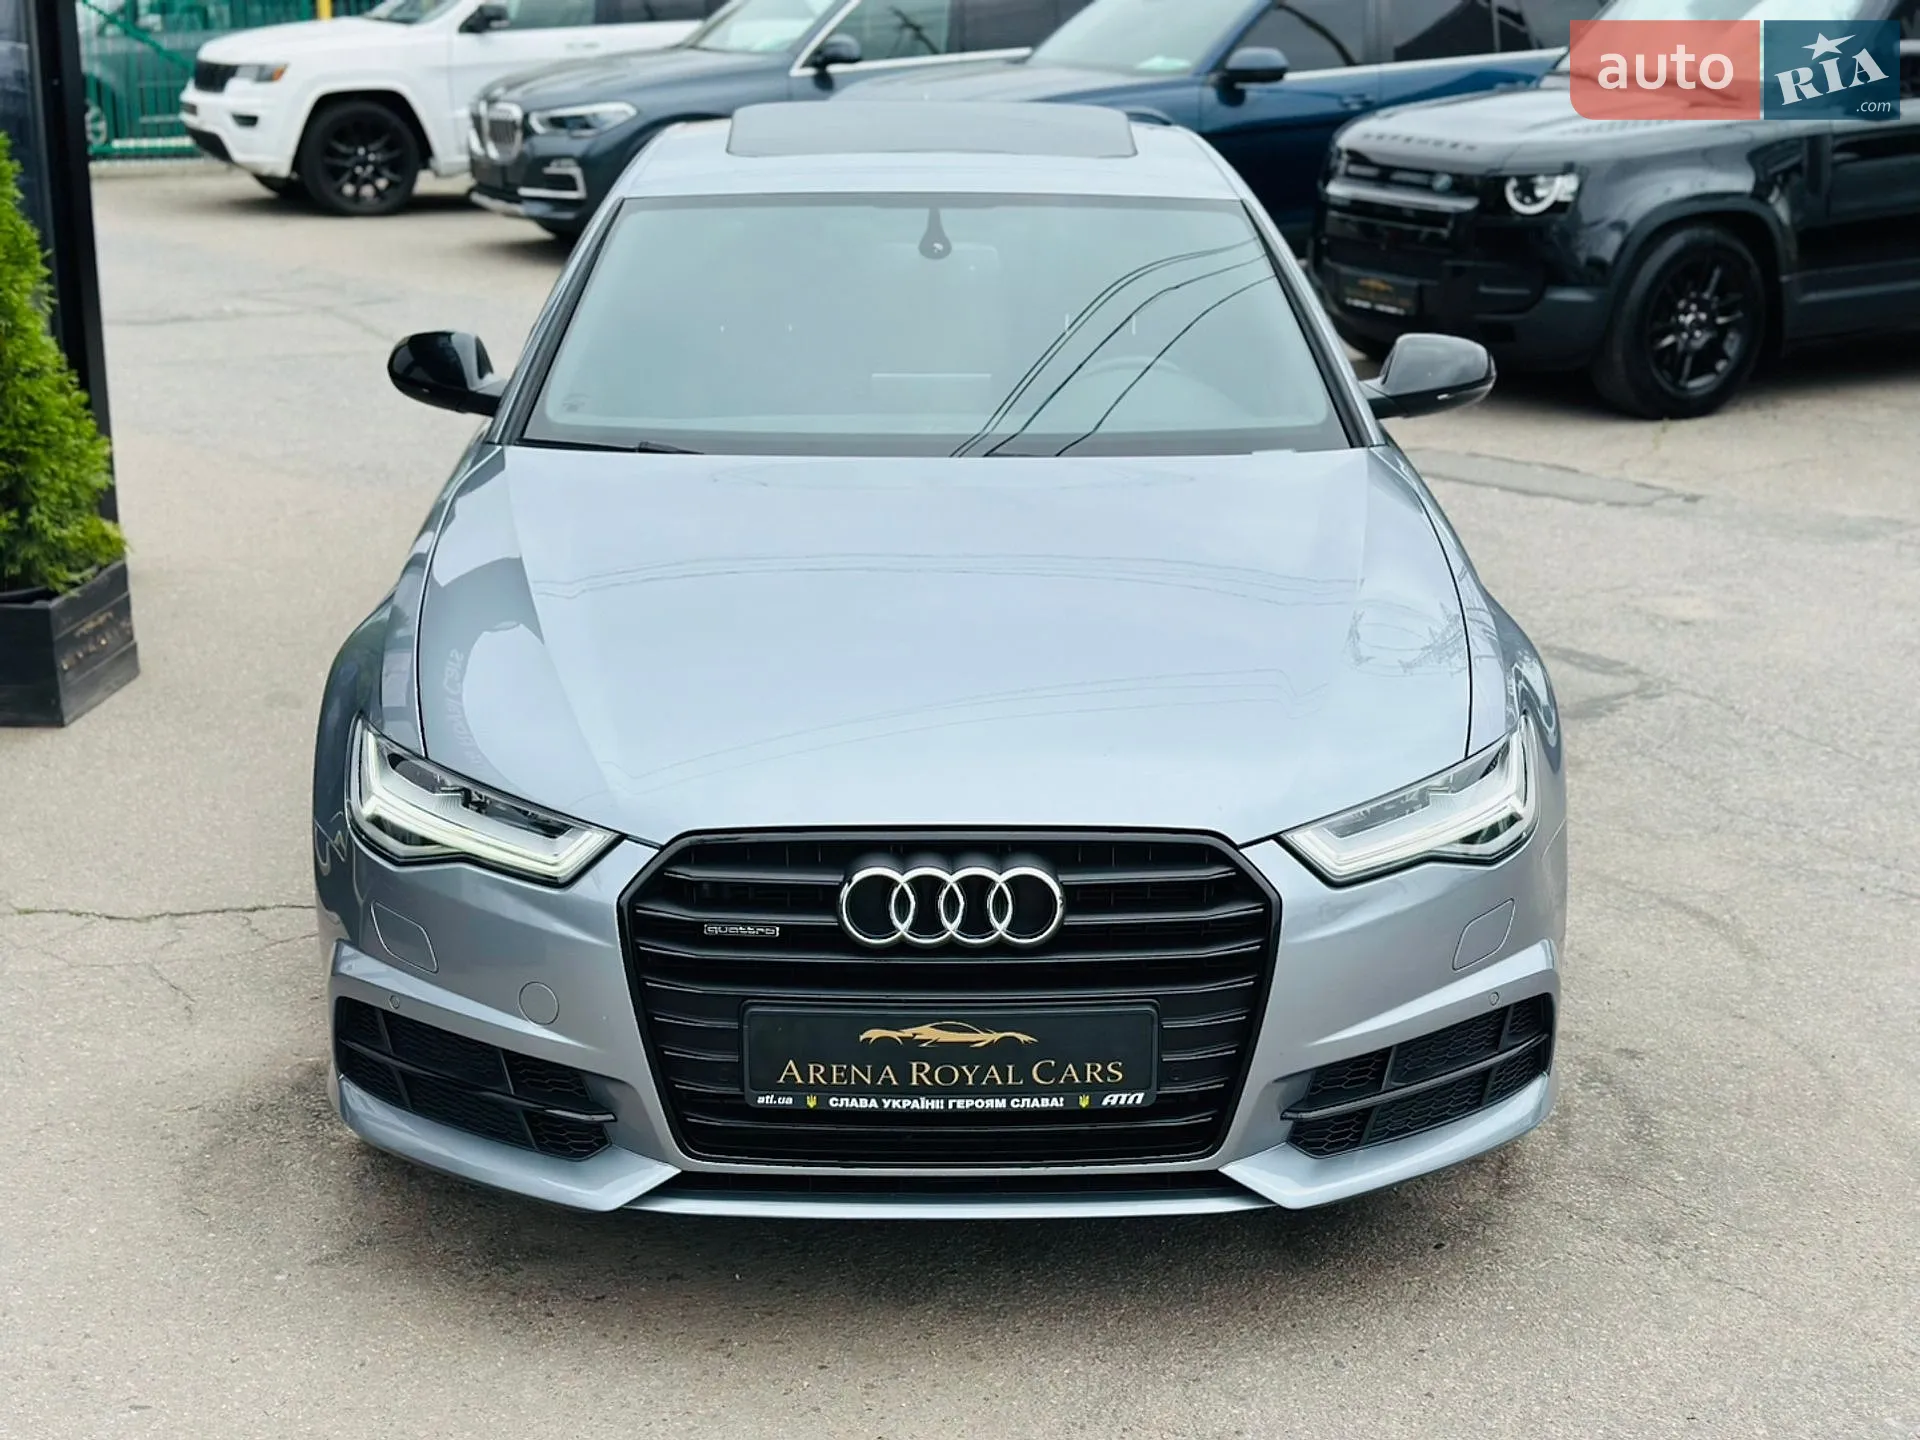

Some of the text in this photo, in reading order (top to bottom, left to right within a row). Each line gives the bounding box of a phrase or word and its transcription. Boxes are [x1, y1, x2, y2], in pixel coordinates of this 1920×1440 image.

[707, 926, 776, 936] quattro
[776, 1059, 1124, 1087] ARENA ROYAL CARS
[757, 1094, 793, 1105] atl.ua
[829, 1097, 879, 1109] СЛАВА
[948, 1098, 1007, 1110] ГЕРОЯМ
[1010, 1096, 1065, 1108] СЛАВА!
